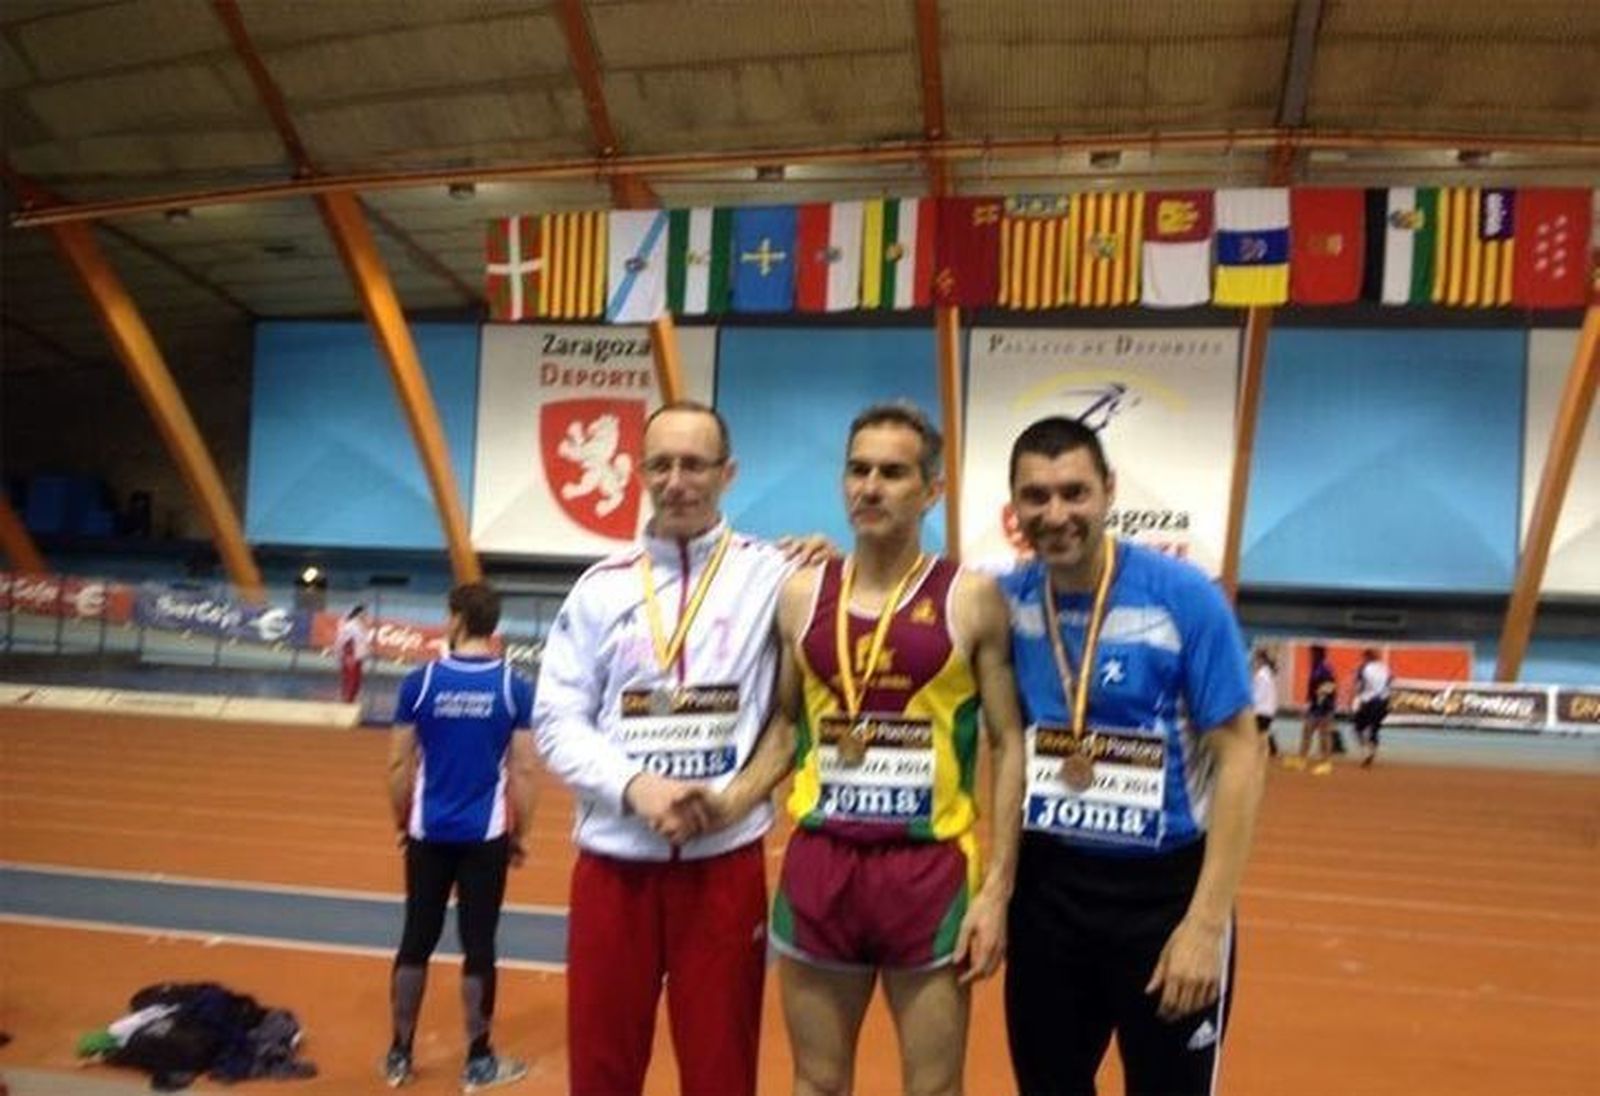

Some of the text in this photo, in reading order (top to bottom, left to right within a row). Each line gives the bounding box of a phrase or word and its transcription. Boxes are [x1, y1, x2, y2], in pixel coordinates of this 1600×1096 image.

[542, 333, 651, 363] Zaragoza
[541, 364, 650, 387] DEPORTE
[1107, 509, 1190, 535] agoza
